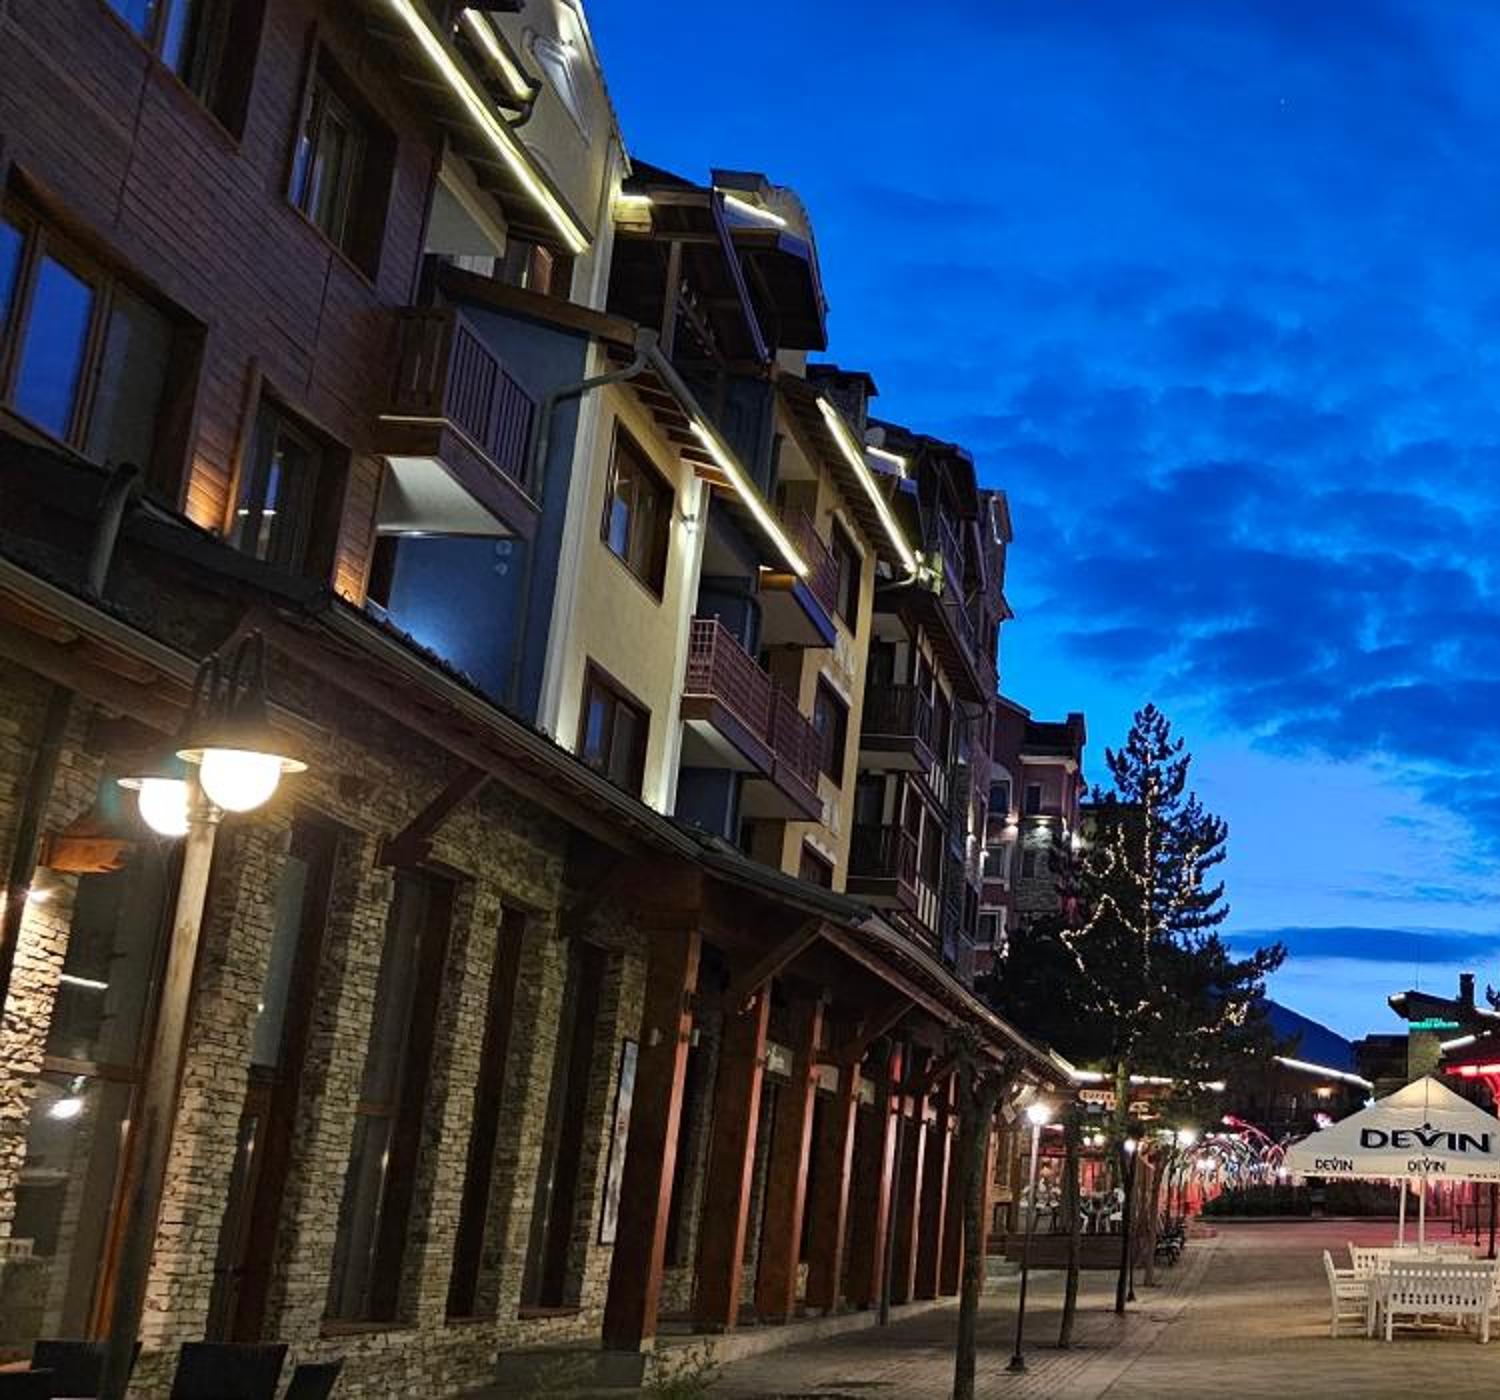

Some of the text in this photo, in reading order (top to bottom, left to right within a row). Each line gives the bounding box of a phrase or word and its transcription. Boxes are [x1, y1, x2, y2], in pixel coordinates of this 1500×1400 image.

[1360, 1123, 1491, 1152] DEVIN
[1315, 1156, 1353, 1171] DEVIN
[1407, 1157, 1447, 1172] DEVIN
